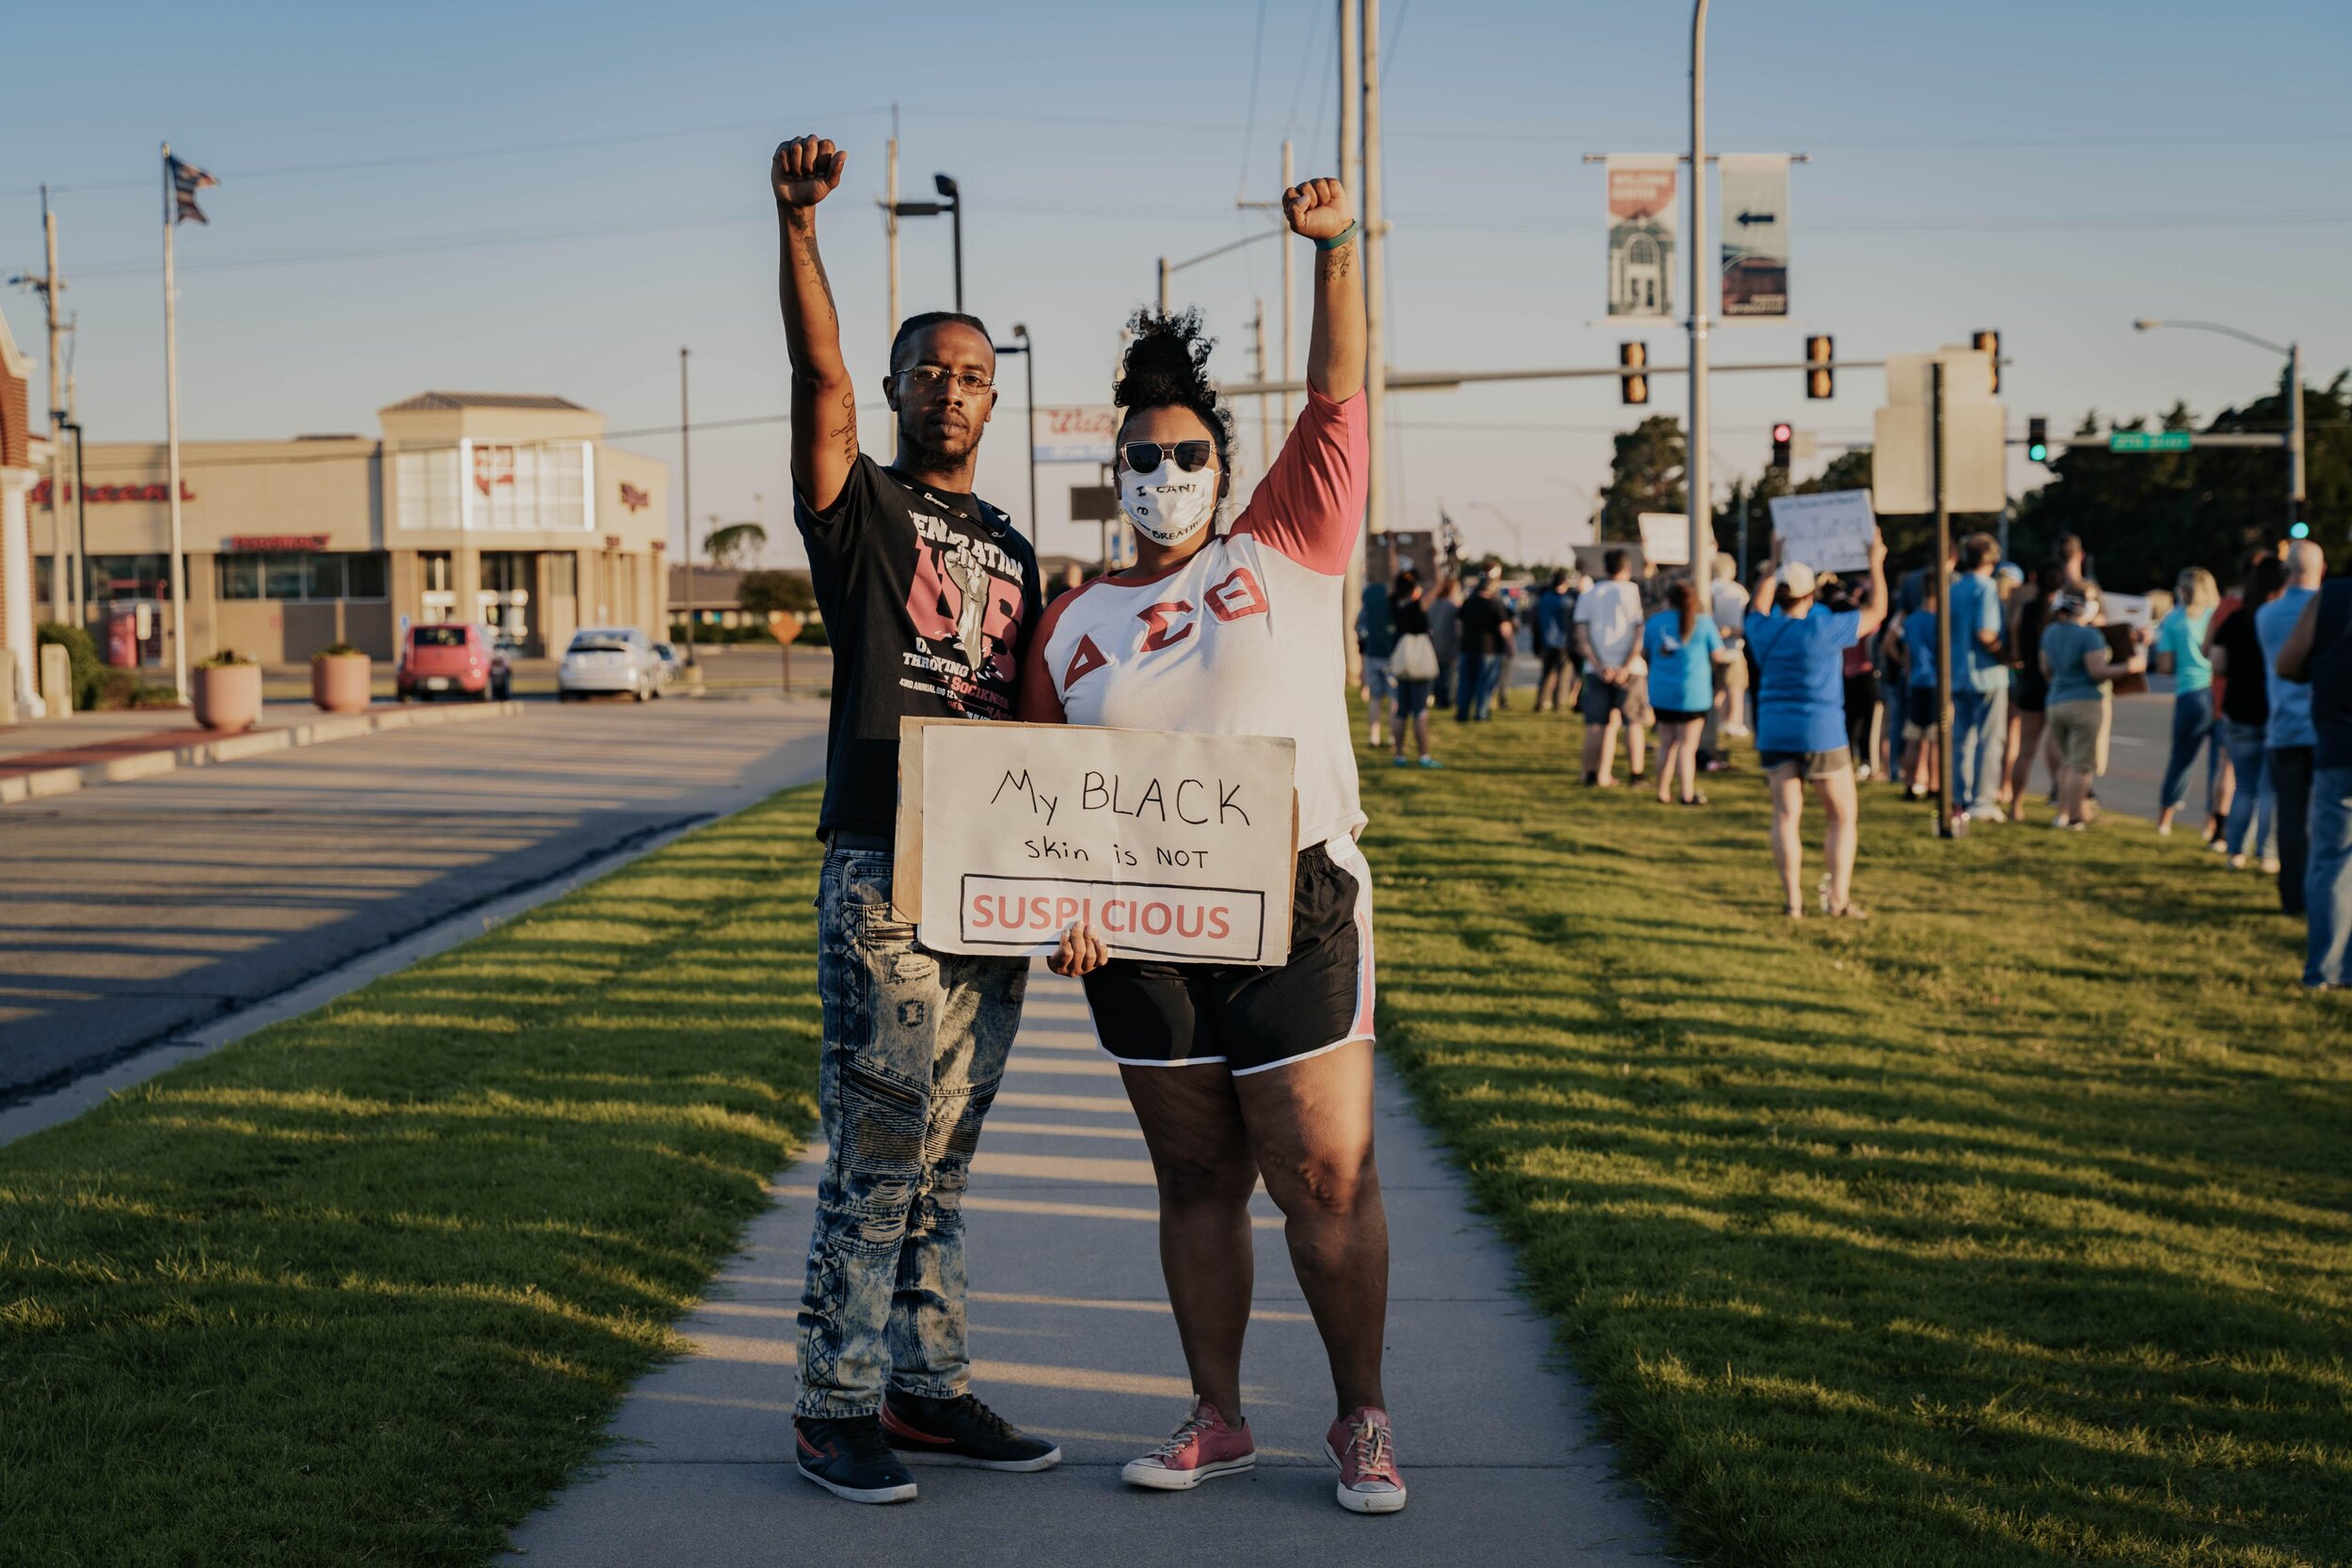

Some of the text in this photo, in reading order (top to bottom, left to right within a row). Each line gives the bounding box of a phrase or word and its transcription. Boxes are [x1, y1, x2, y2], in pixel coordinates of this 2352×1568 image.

[1136, 485, 1147, 498] I
[914, 681, 936, 694] ANNUAL
[936, 686, 946, 696] BIG
[991, 768, 1251, 827] My BLACK
[1025, 835, 1208, 868] skin is NOT
[972, 895, 1231, 940] SUSPICIOUS
